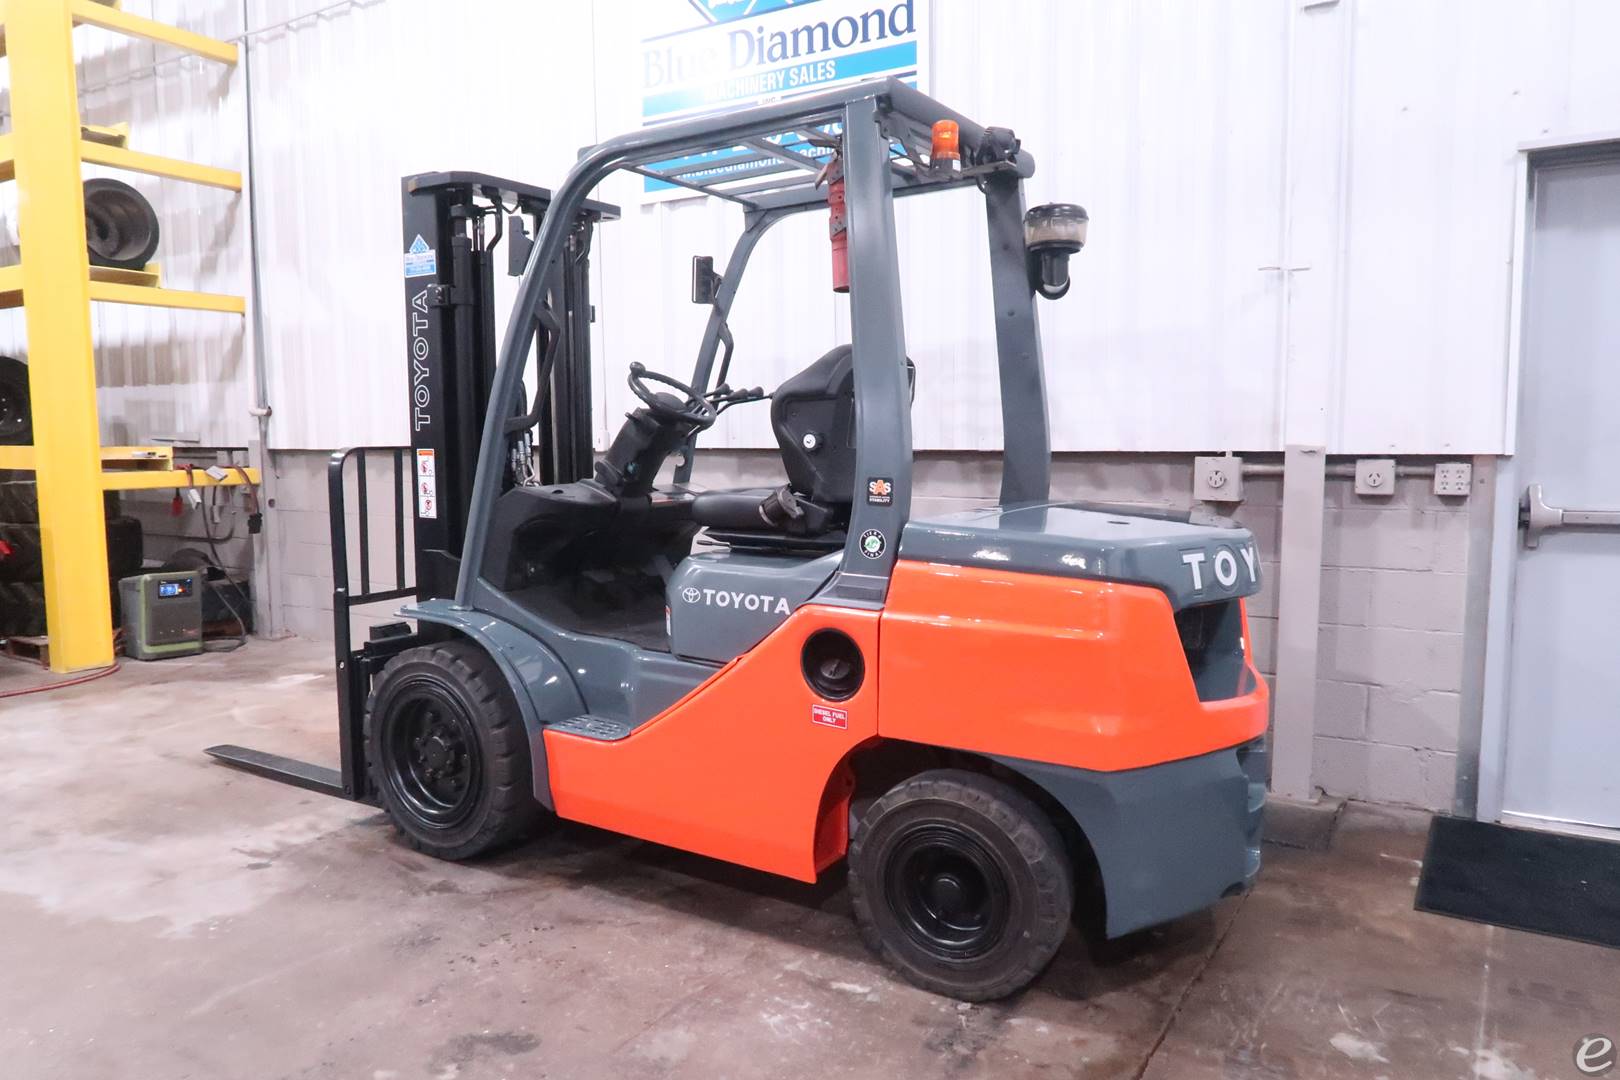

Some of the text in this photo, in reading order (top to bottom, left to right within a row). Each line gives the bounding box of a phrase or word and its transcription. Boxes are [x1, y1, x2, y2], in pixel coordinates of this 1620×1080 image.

[727, 0, 916, 71] Diamond
[789, 60, 836, 87] SALES
[412, 289, 431, 431] TOYOTA
[869, 480, 891, 495] SAS
[1182, 546, 1263, 590] TOY
[703, 588, 790, 615] TOYOTA
